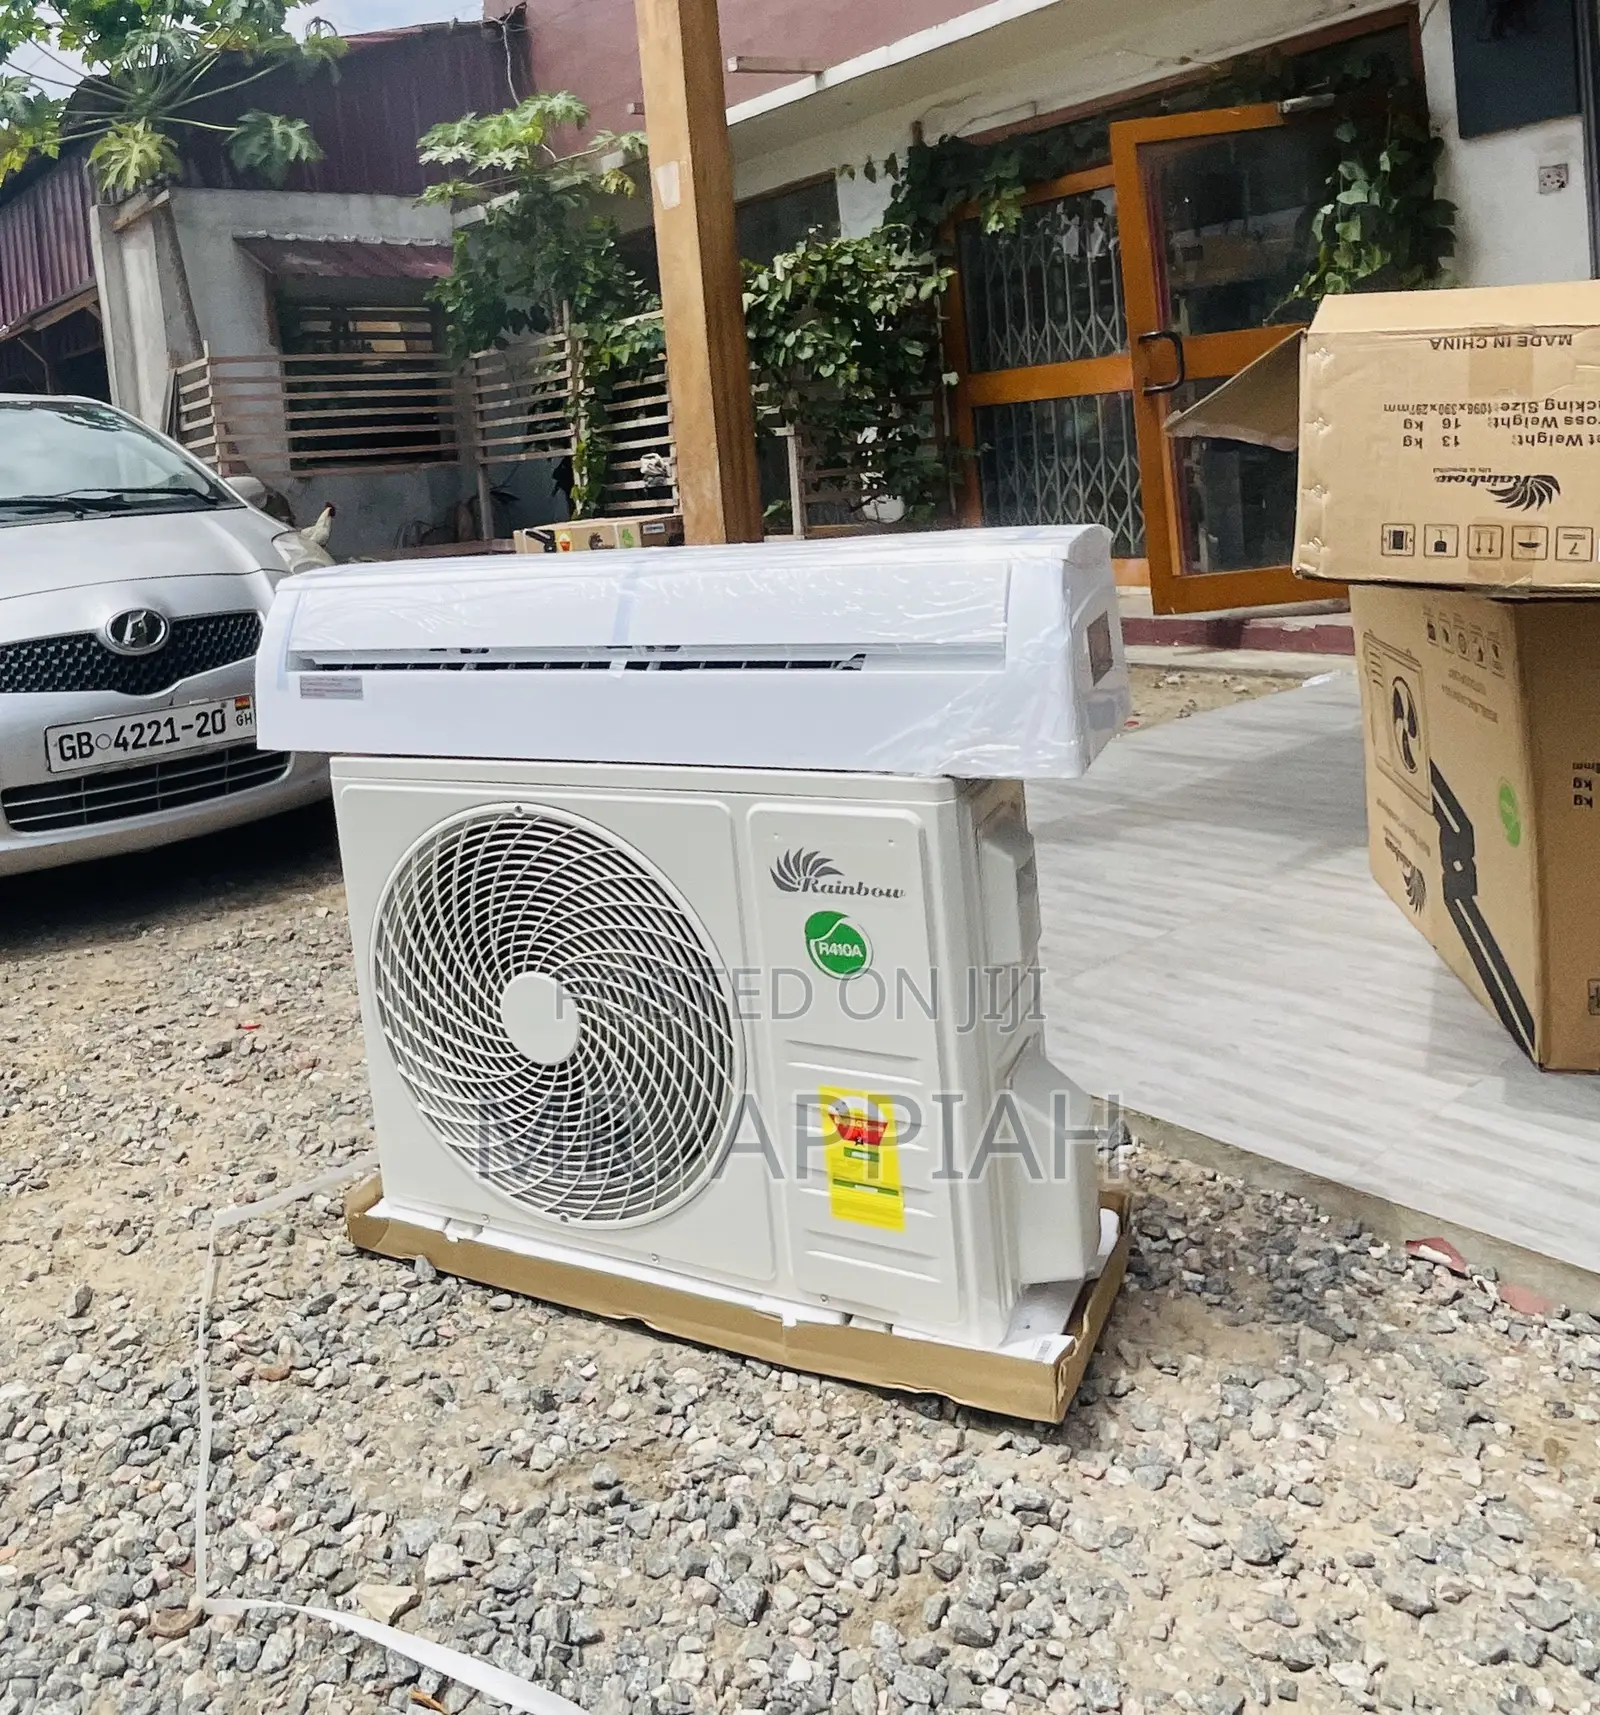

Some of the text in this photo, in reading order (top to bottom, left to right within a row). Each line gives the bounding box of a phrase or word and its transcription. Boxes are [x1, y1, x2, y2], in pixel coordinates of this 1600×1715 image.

[1430, 334, 1573, 350] MADE IN CHINA
[1544, 398, 1600, 412] cking
[1403, 416, 1600, 431] oss Weight: 16 kg
[1403, 435, 1423, 449] kg
[1442, 435, 1460, 447] 13
[1512, 432, 1584, 446] Weight:
[1434, 474, 1531, 487] Rainbow
[236, 711, 253, 726] GH
[113, 709, 227, 751] 4221-20
[1573, 777, 1592, 791] kg
[1574, 794, 1593, 808] kg
[797, 877, 906, 899] Rainbow
[818, 942, 863, 957] R410A
